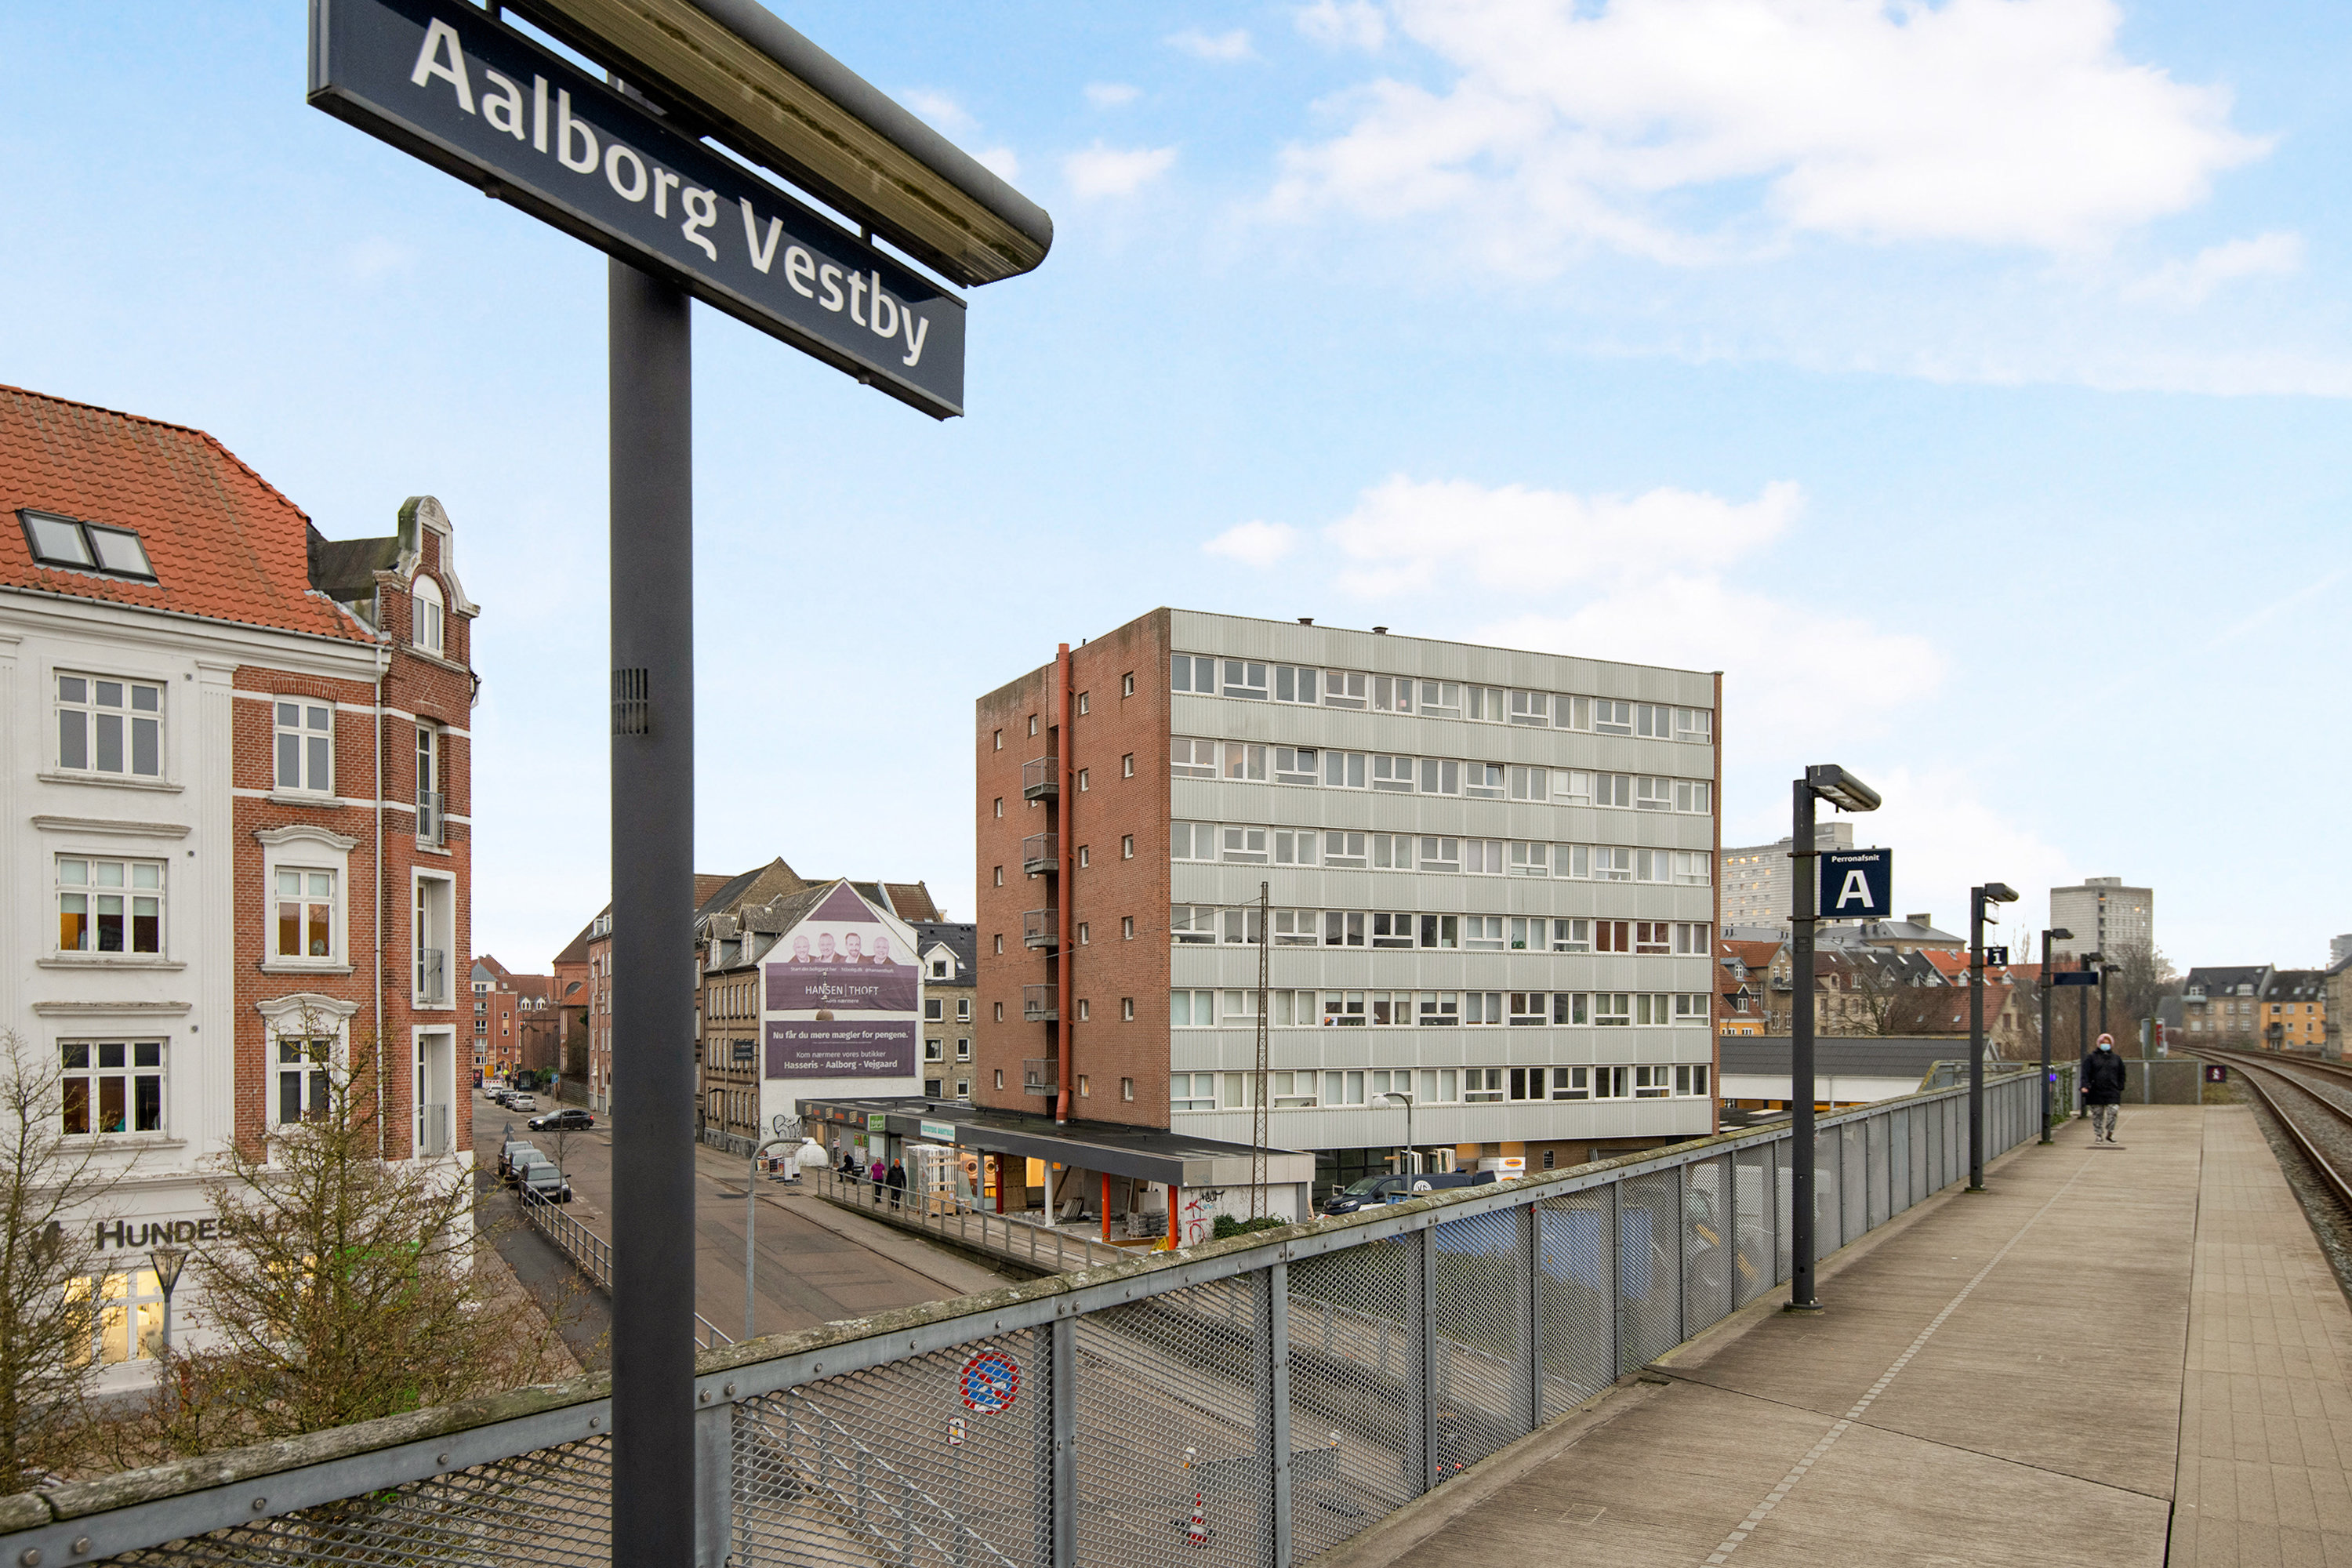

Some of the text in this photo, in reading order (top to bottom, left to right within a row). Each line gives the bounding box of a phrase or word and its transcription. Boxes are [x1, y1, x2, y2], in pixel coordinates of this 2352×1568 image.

[410, 16, 930, 366] Aalborg Vestby
[1835, 869, 1875, 909] A
[1992, 953, 2002, 964] 1
[805, 985, 879, 995] HANSEN THOFT
[786, 1029, 797, 1039] får
[832, 1030, 861, 1040] mægler
[862, 1030, 873, 1039] for
[784, 1060, 818, 1069] Hasseris
[826, 1059, 857, 1070] Aalborg
[863, 1058, 898, 1069] Vejgaard
[96, 1211, 278, 1251] HUNDES
